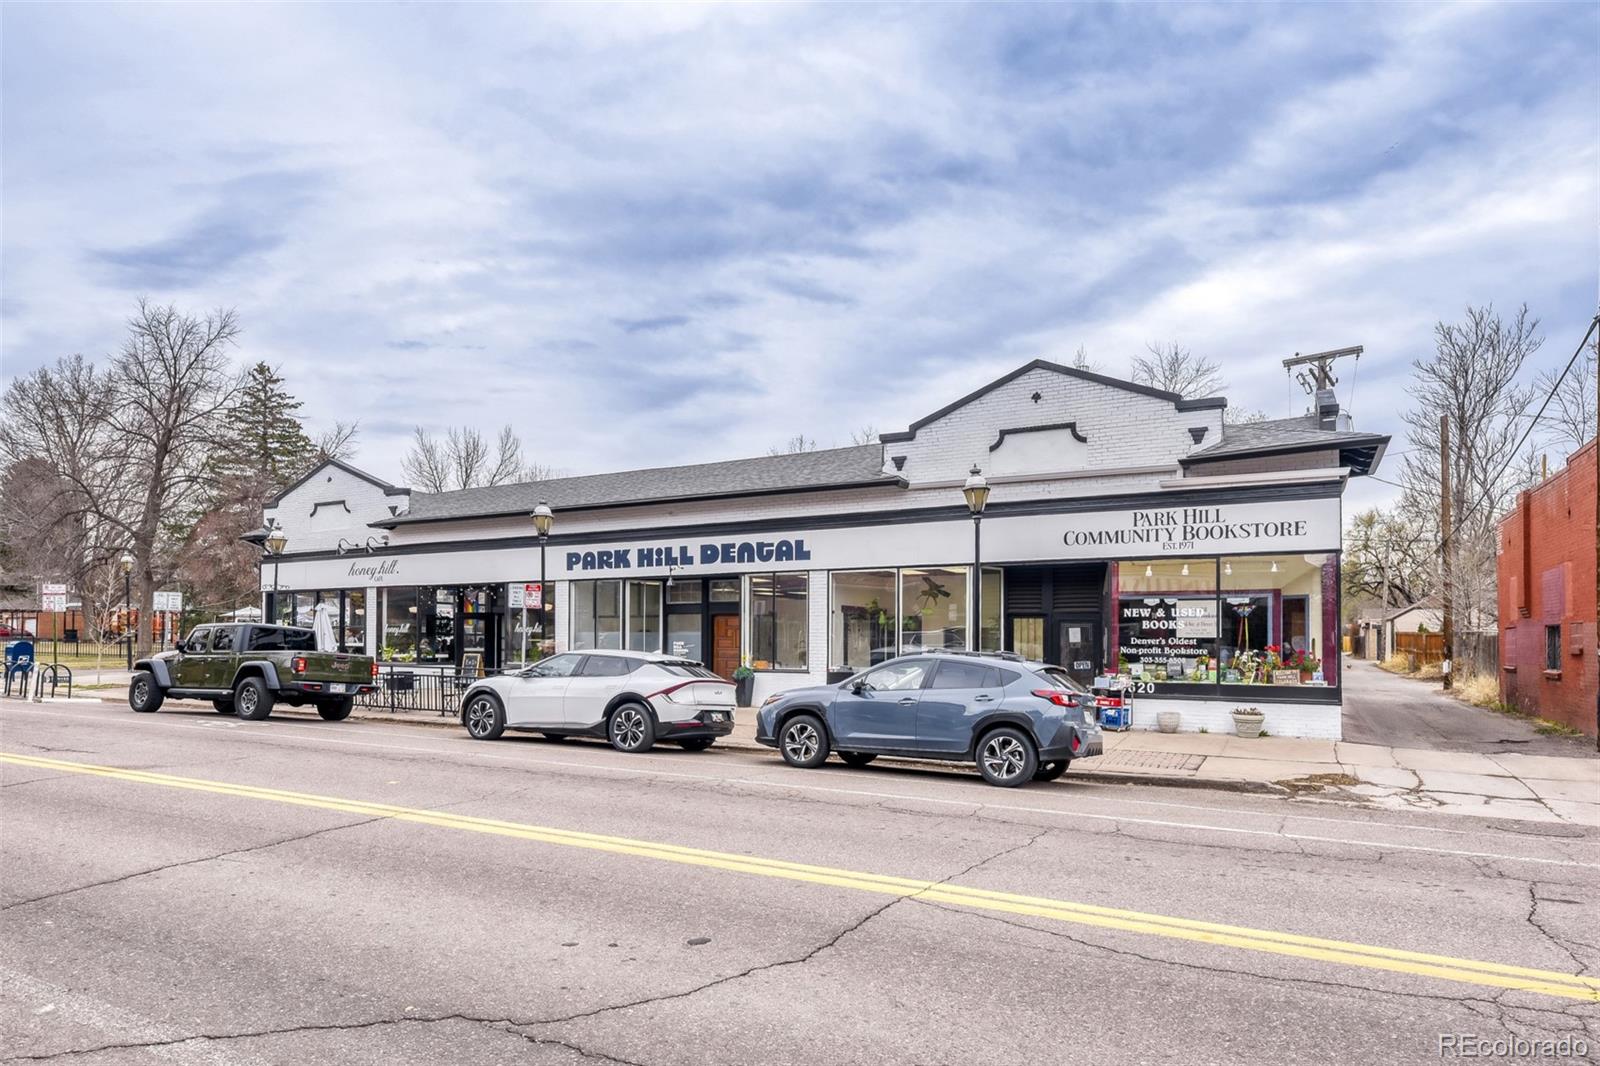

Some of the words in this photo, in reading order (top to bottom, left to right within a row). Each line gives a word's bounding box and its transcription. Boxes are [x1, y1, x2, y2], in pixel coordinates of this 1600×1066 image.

[1133, 511, 1178, 527] PARK
[1183, 508, 1226, 524] HILL
[1063, 527, 1175, 546] COMMUNITY
[1182, 520, 1307, 541] BOOKSTORE
[566, 549, 631, 571] PARK
[700, 539, 811, 565] DENTAL
[348, 561, 377, 581] honey
[1123, 608, 1151, 618] NEW
[1156, 608, 1166, 617] &
[1171, 607, 1204, 617] USED
[1142, 620, 1184, 630] BOOKS
[1130, 637, 1166, 645] Denver's
[1168, 637, 1197, 645] Oldest
[1120, 646, 1162, 655] Non-profit
[1164, 646, 1208, 656] Bookstore
